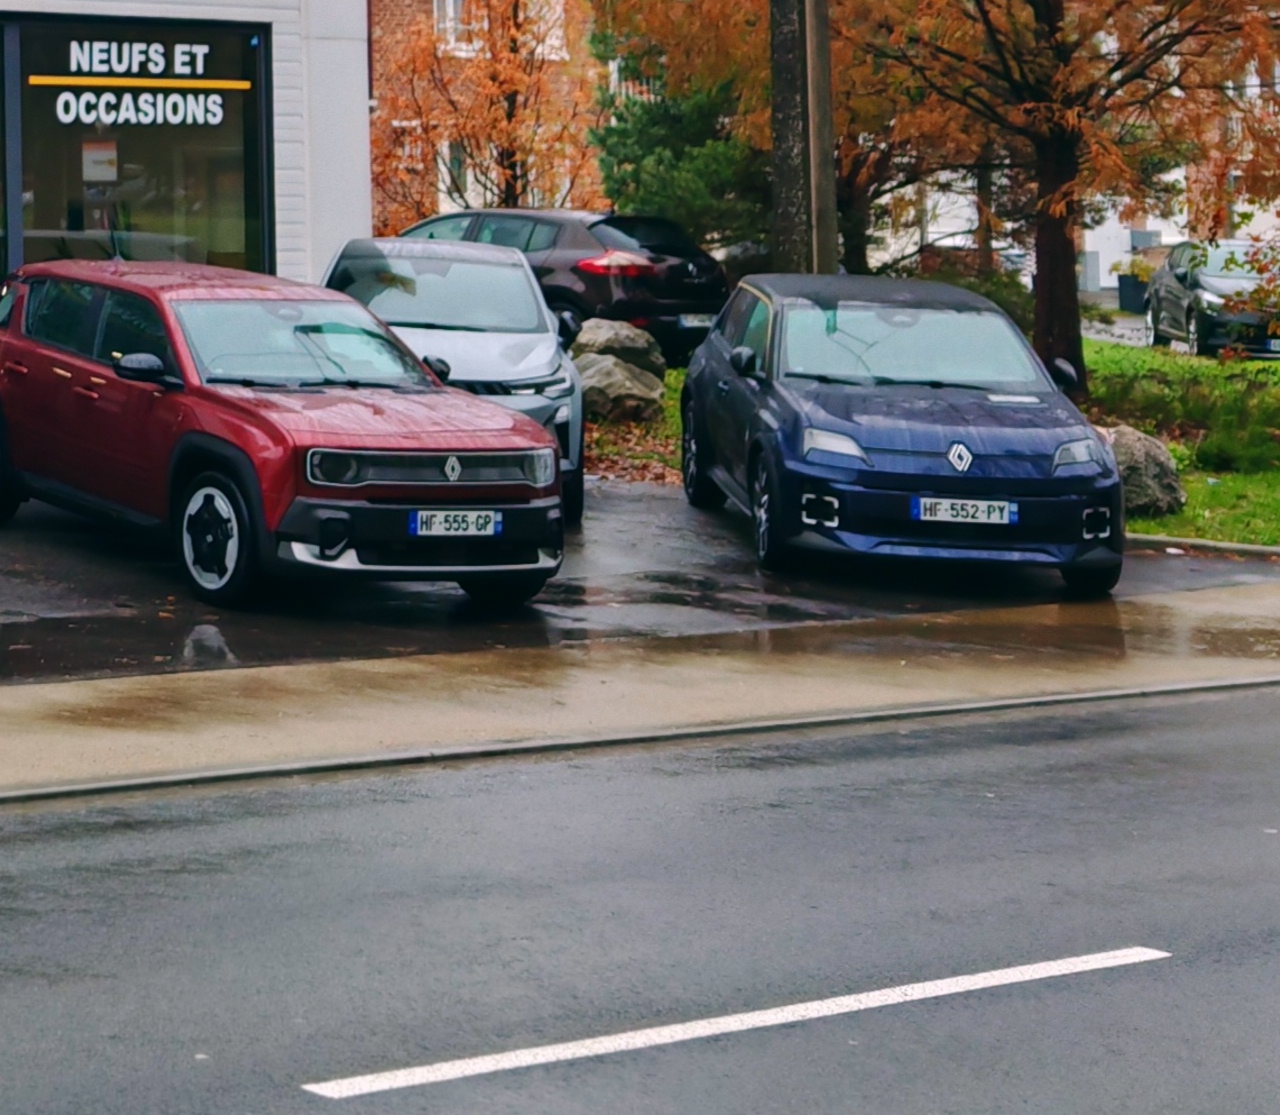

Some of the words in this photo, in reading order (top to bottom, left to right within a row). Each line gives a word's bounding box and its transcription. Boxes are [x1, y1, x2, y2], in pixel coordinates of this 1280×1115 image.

[70, 40, 166, 75] NEUFS
[174, 43, 210, 76] ET
[56, 91, 224, 126] OCCASIONS
[420, 513, 492, 532] HF-555-GP
[923, 501, 1006, 521] HF-552-PY
